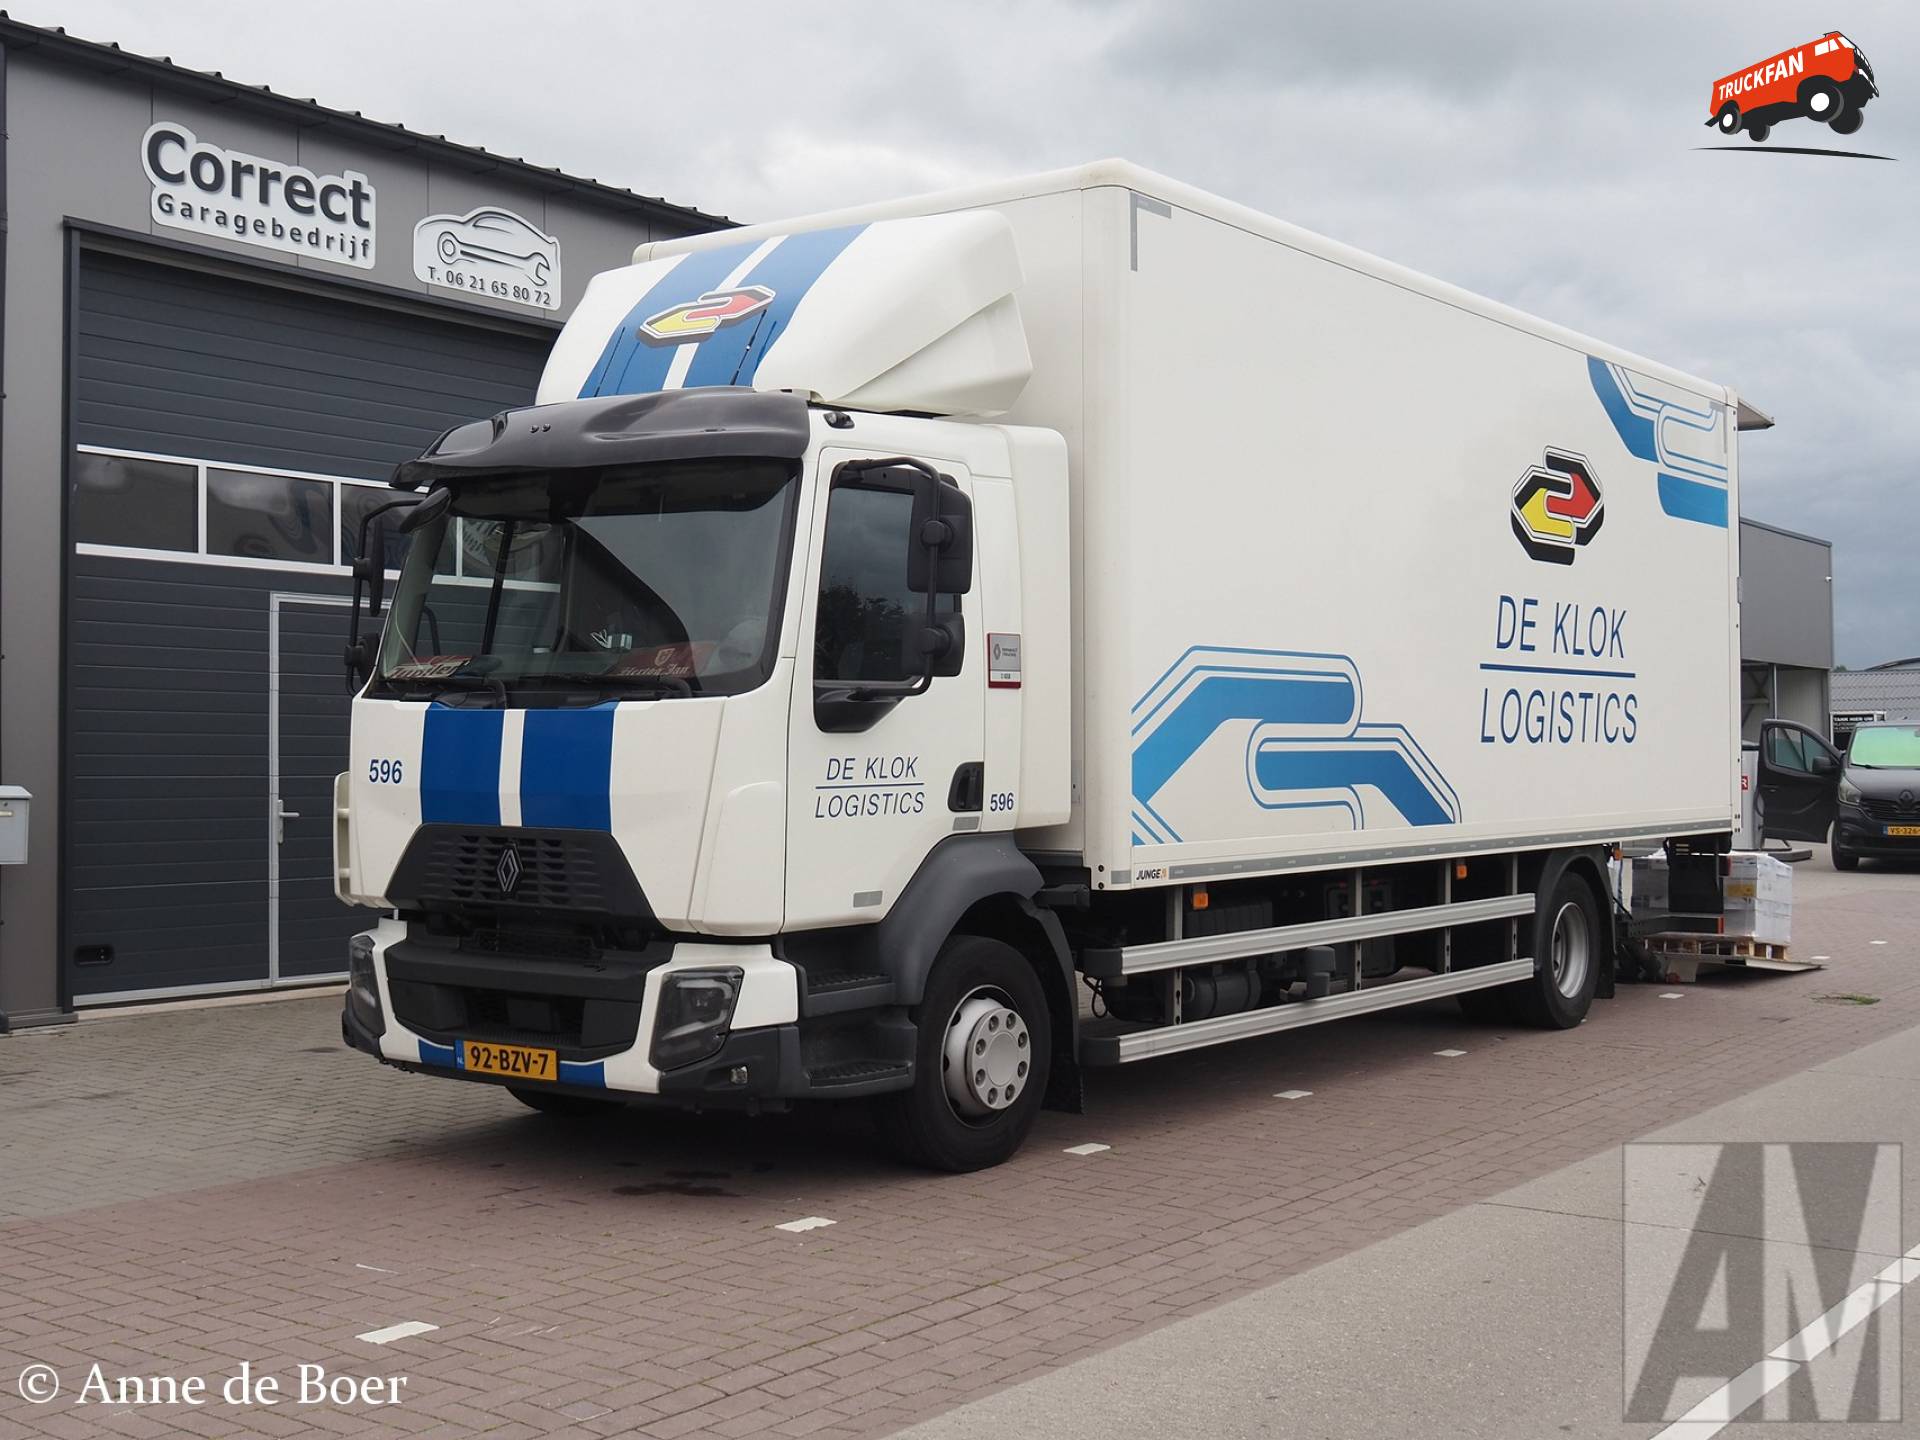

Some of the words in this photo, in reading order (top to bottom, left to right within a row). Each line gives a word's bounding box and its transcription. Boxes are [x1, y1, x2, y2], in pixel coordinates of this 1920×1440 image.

[146, 130, 371, 229] Correct
[157, 193, 370, 260] Garagebedrijf
[427, 265, 441, 281] T.
[446, 270, 464, 286] 06
[469, 275, 485, 290] 21
[491, 280, 508, 296] 65
[513, 285, 530, 301] 80
[535, 290, 550, 305] 72
[1496, 595, 1539, 652] DE
[1553, 602, 1627, 659] KLOK
[1480, 688, 1638, 744] LOGISTICS
[369, 759, 403, 784] 596
[826, 757, 856, 781] DE
[865, 756, 919, 780] KLOK
[815, 791, 926, 819] LOGISTICS
[990, 792, 1015, 812] 596
[470, 1045, 549, 1075] 92-BZV-7
